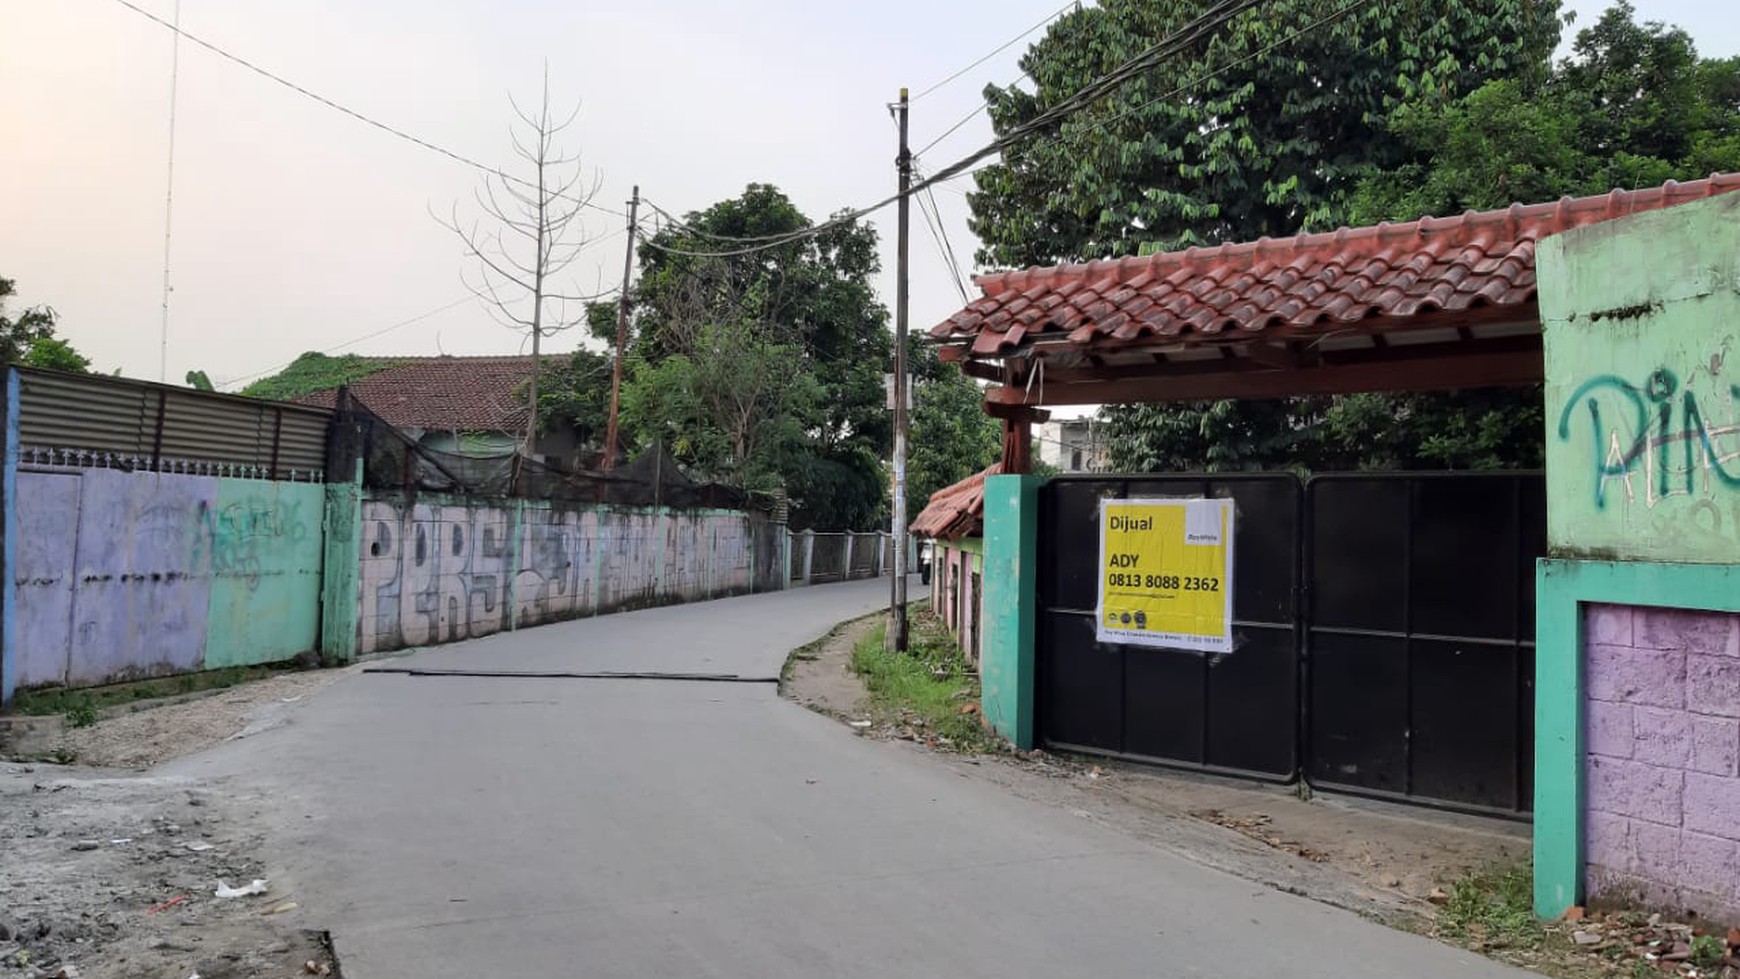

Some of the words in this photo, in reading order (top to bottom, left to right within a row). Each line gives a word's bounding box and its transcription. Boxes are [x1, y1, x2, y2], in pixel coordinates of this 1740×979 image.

[1110, 516, 1153, 533] Dijual
[1109, 553, 1140, 568] ADY
[1108, 573, 1141, 587] 0813
[1145, 575, 1179, 590] 8088
[1184, 577, 1219, 592] 2362
